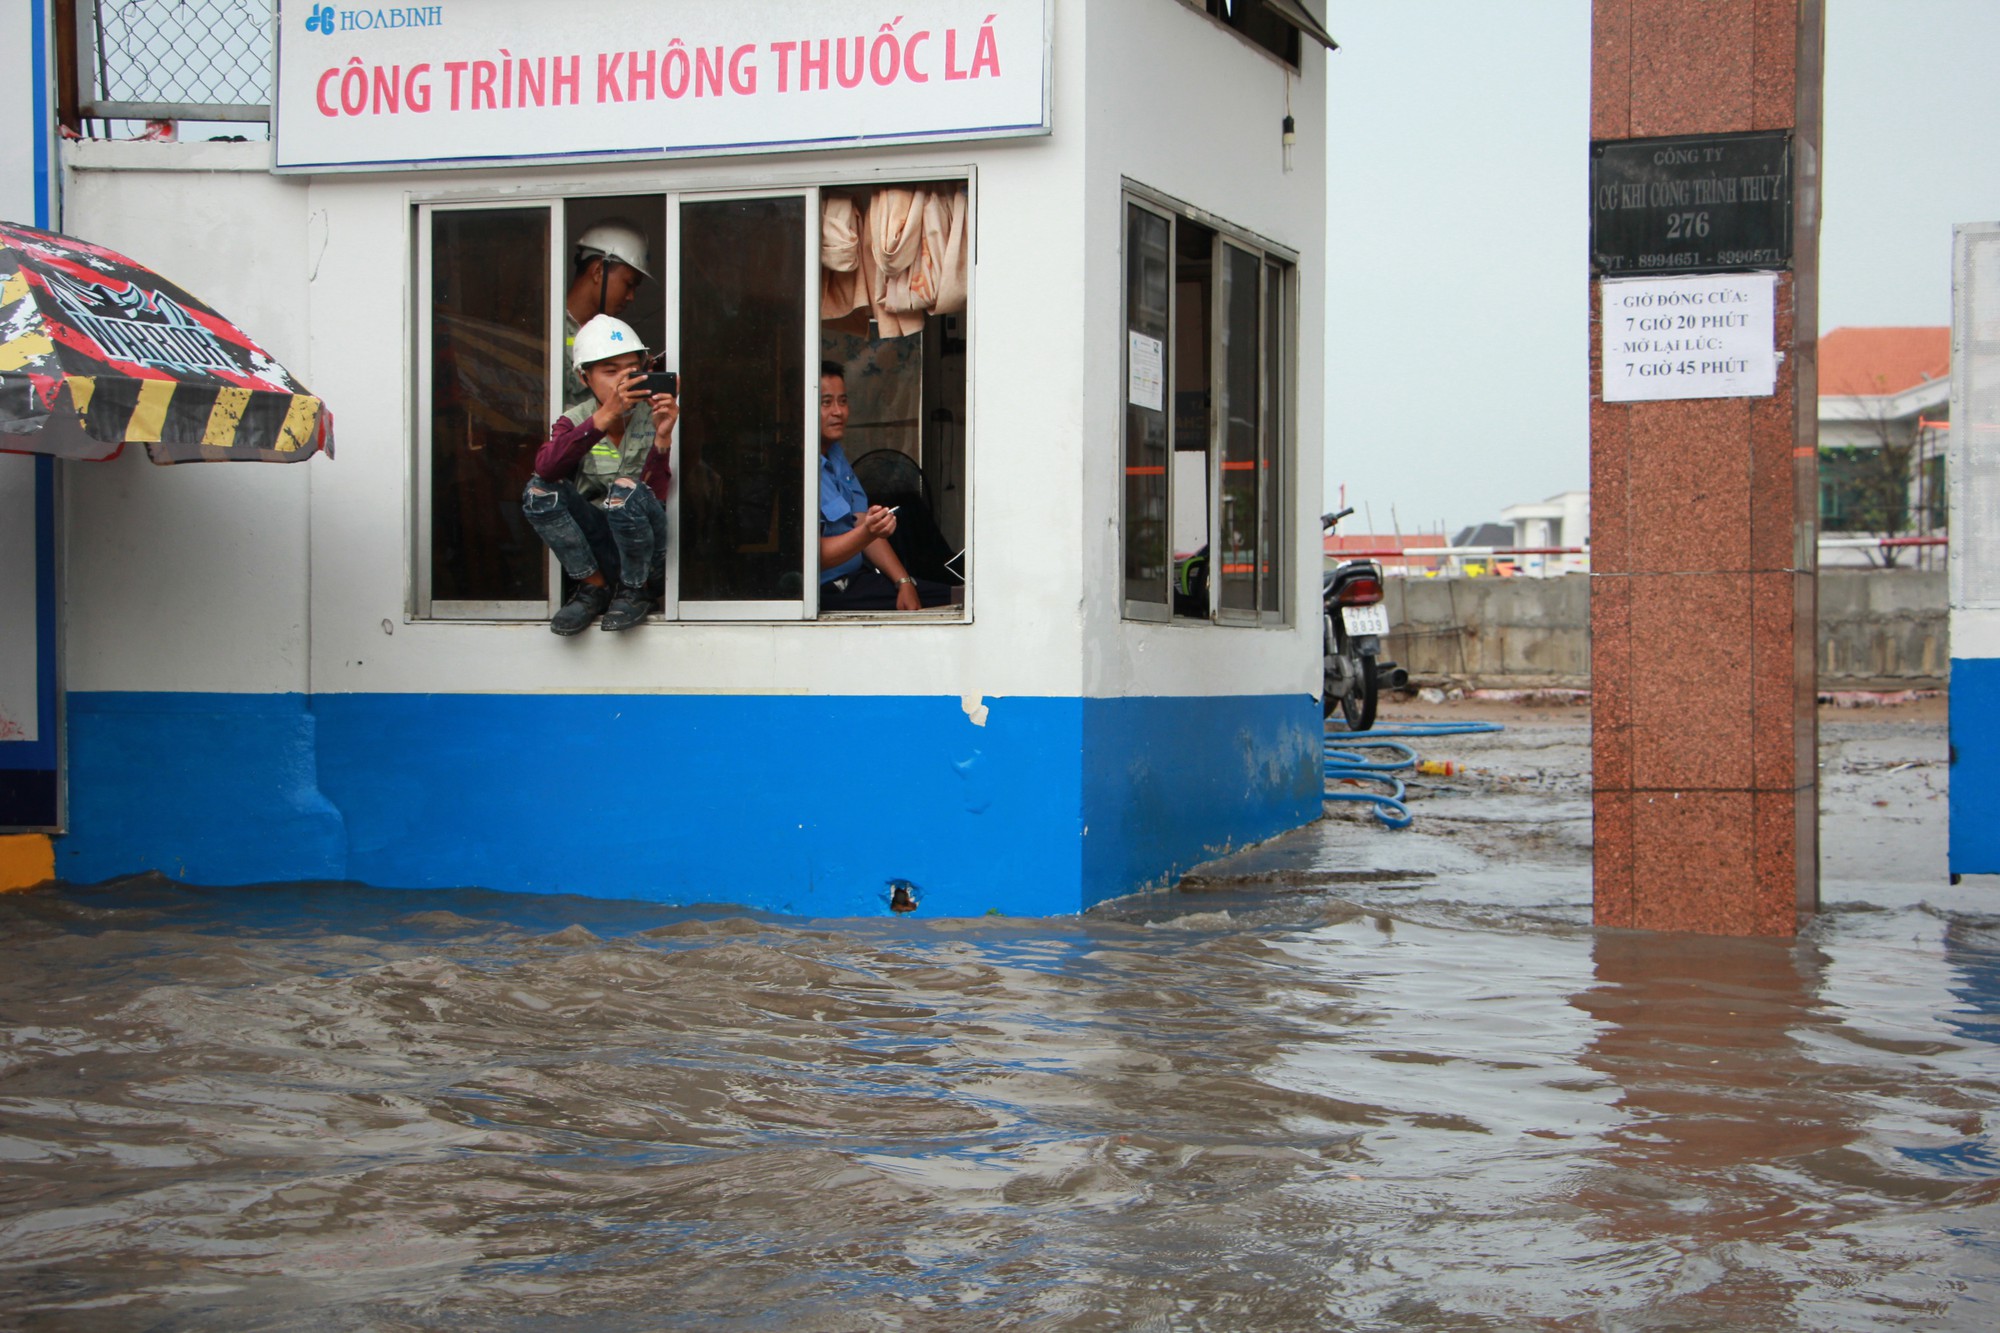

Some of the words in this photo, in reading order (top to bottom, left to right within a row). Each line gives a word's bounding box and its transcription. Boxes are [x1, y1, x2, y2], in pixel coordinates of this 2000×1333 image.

[340, 6, 443, 31] HOABINH
[316, 56, 432, 118] CÔNG
[444, 48, 580, 112] TRÌNH
[597, 37, 757, 104] KHÔNG
[770, 15, 931, 93] THUỐC
[945, 13, 1001, 81] LÁ
[1653, 146, 1699, 166] CÔNG
[1703, 147, 1724, 162] TY
[1650, 173, 1690, 208] CÔNG
[1692, 170, 1737, 205] TRÌNH
[1666, 211, 1710, 239] 276
[1638, 252, 1700, 267] 8994651
[1623, 291, 1654, 308] GIỜ
[1657, 290, 1704, 307] ĐÓNG
[1625, 317, 1635, 332] 7
[1639, 314, 1673, 331] GIỜ
[1677, 315, 1696, 330] 20
[1701, 311, 1749, 328] PHÚT
[65, 309, 251, 379] WARRIOR
[1653, 339, 1680, 355] LẠI
[1685, 335, 1722, 351] LÚC:
[1625, 363, 1635, 377] 7
[1639, 359, 1673, 376] GIỜ
[1676, 360, 1696, 375] 45
[1701, 356, 1749, 374] PHÚT
